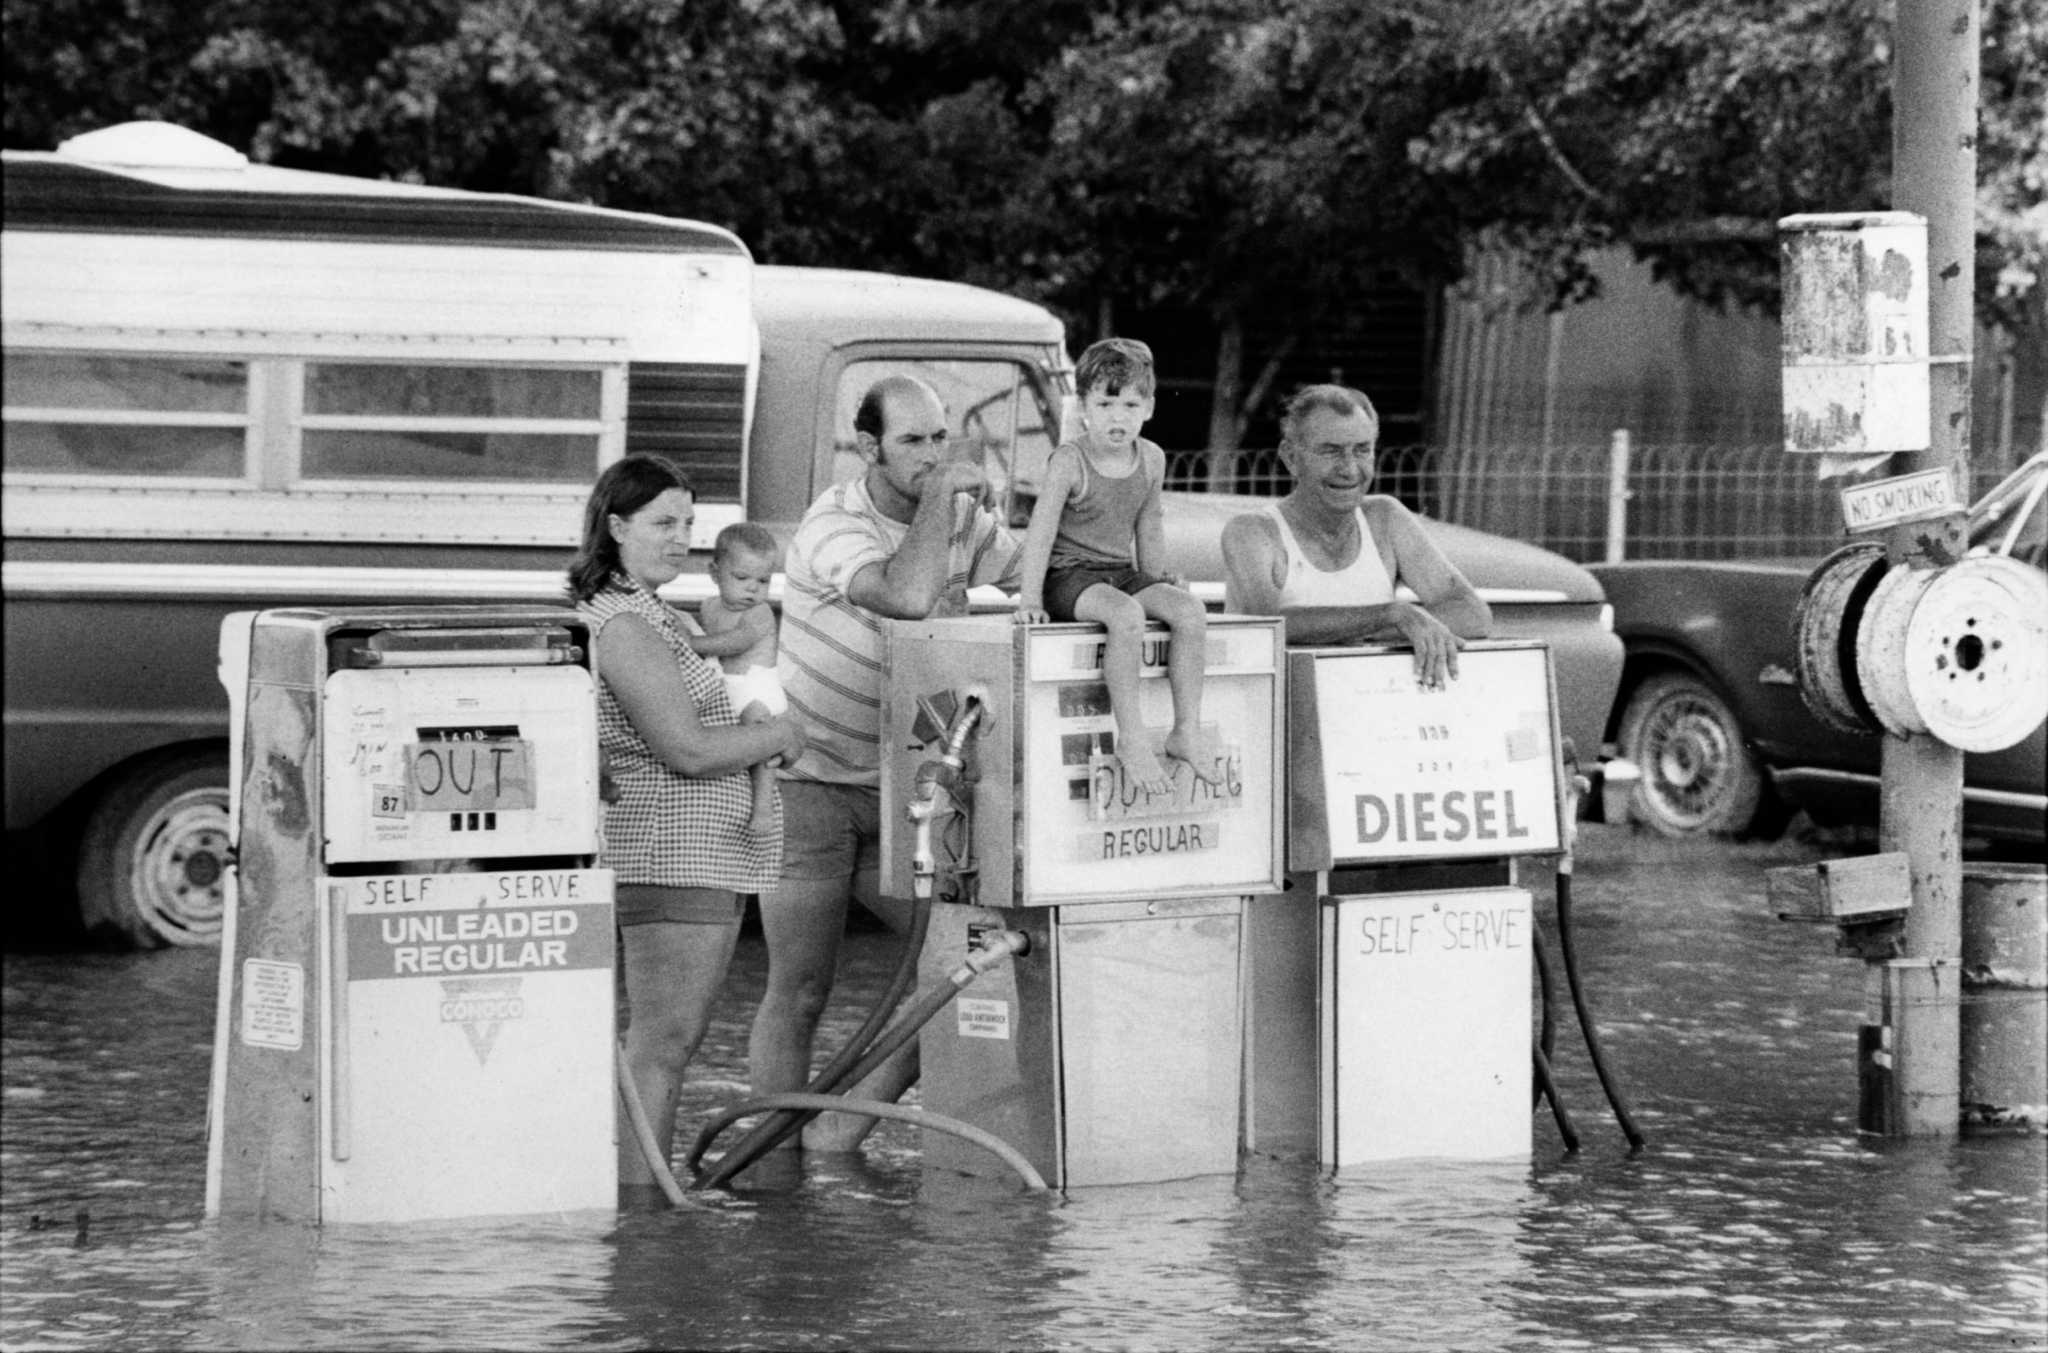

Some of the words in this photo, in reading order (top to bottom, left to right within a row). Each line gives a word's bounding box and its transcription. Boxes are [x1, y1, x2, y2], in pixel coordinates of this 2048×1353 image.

[1850, 496, 1871, 523] NO
[1873, 479, 1945, 518] SMOKING
[415, 748, 514, 798] OUT
[1095, 764, 1152, 810] OU
[381, 796, 399, 812] 87
[1355, 789, 1529, 843] DIESEL
[1103, 823, 1204, 860] REGULAR
[365, 877, 433, 905] SELF
[498, 874, 580, 899] SERVE
[381, 909, 579, 944] UNLEADED
[1360, 914, 1425, 955] SELF
[1441, 908, 1527, 951] SERVE
[394, 940, 568, 974] REGULAR
